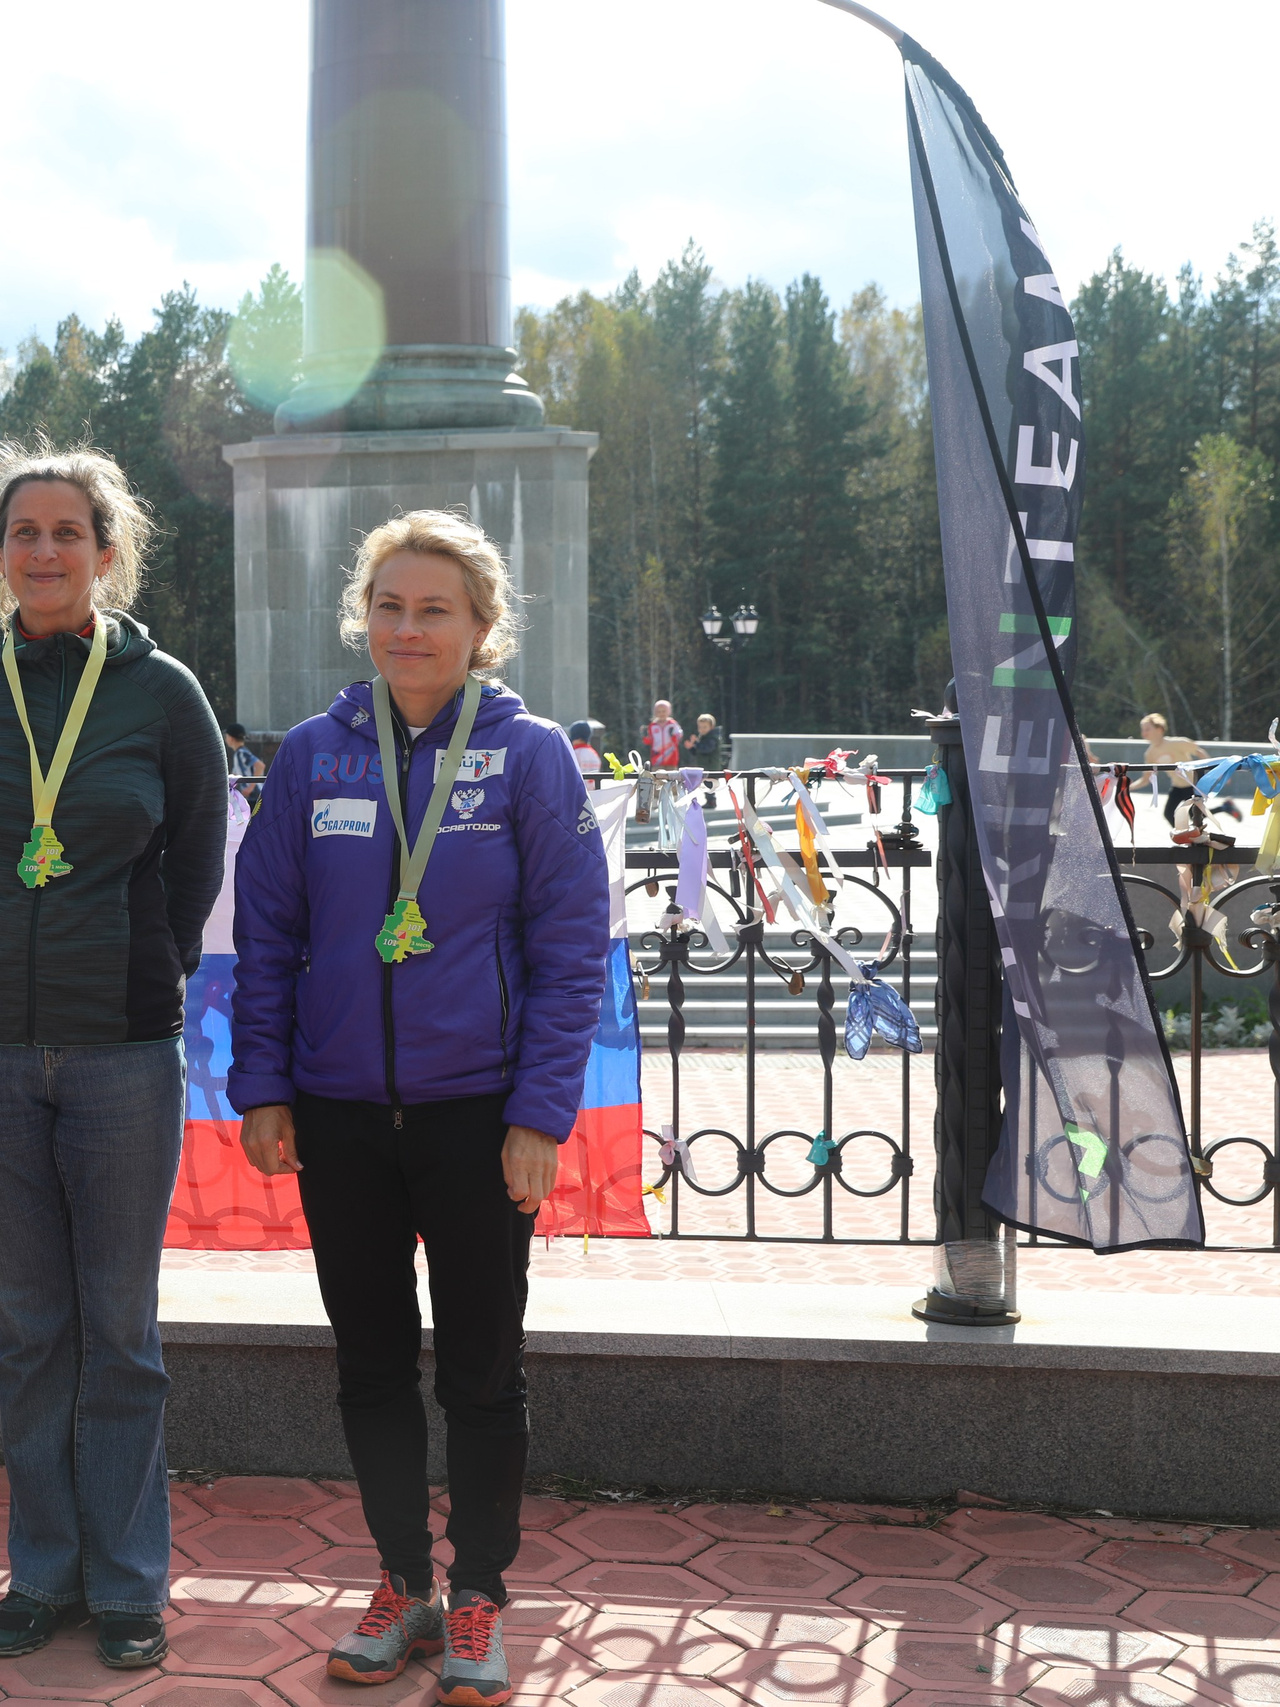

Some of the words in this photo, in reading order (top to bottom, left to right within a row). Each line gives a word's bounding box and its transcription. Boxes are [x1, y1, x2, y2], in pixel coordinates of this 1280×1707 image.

[978, 217, 1081, 1018] RIENTEA
[327, 819, 371, 833] GAZPROM
[437, 823, 501, 834] ОСАВТОДОР
[407, 924, 421, 932] 101
